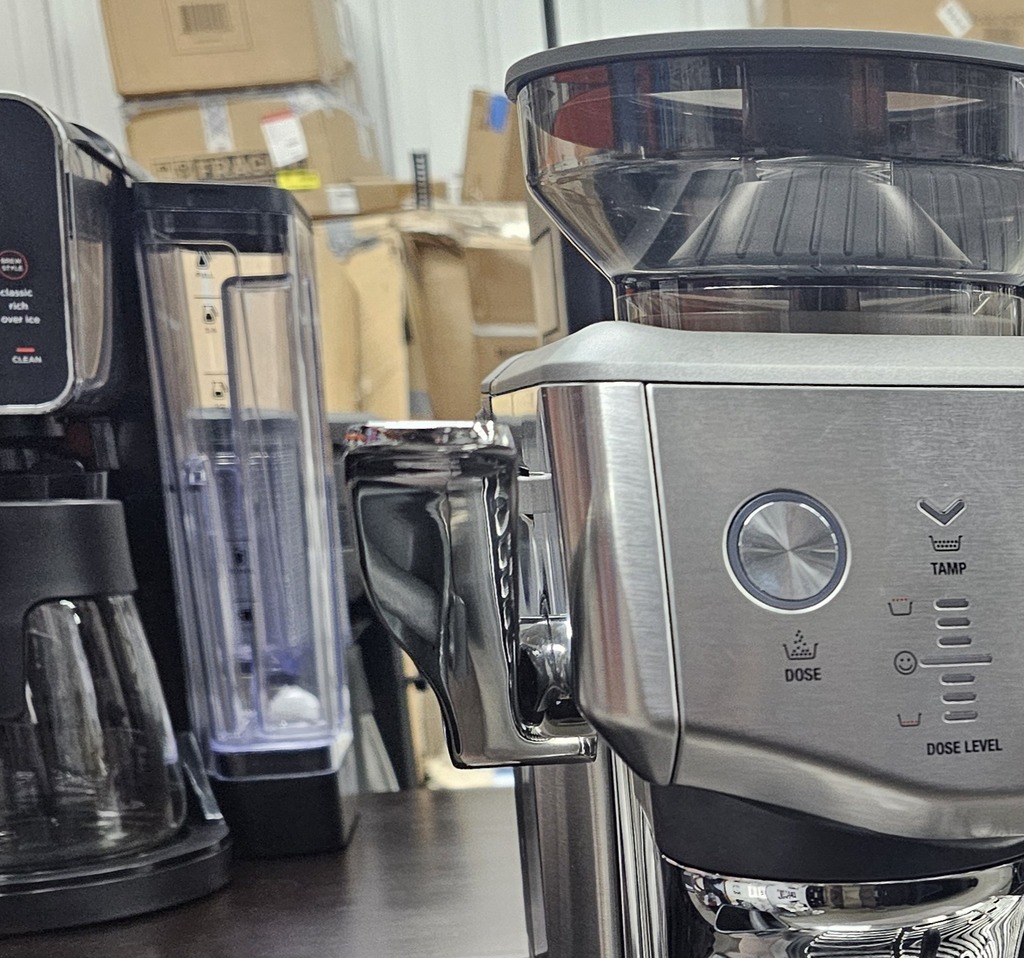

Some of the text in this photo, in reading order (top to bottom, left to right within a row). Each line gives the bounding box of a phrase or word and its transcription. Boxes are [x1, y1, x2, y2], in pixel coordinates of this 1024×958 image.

[1, 264, 24, 273] STYLE
[0, 287, 34, 298] classic
[8, 301, 30, 311] rich
[1, 314, 42, 324] over ice
[11, 355, 43, 364] CLEAN
[930, 561, 967, 576] TAMP
[784, 667, 822, 683] DOSE
[926, 738, 1004, 756] DOSE LEVEL
